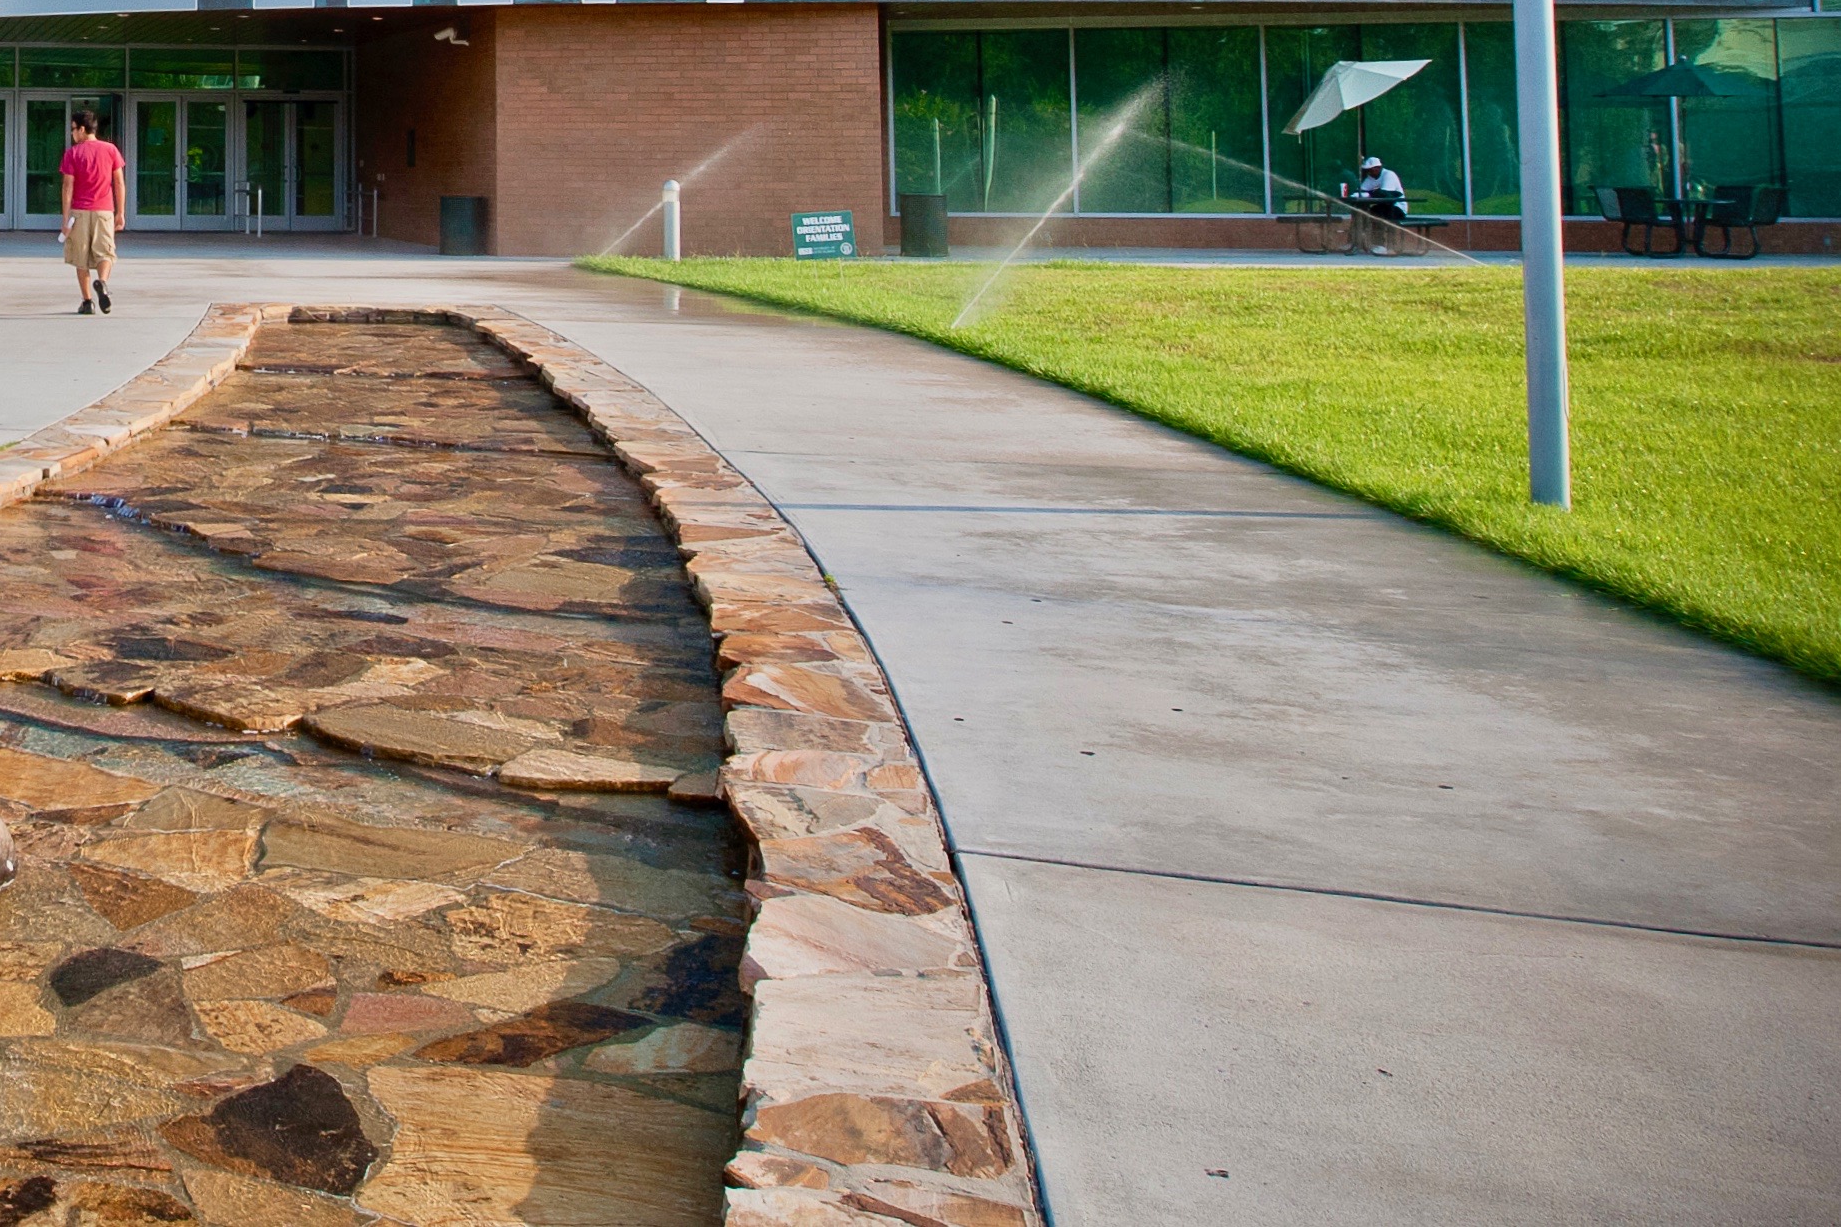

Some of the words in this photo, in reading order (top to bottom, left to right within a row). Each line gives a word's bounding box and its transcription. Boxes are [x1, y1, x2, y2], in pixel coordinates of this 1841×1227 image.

[802, 216, 843, 225] WELCOME
[796, 224, 850, 234] ORIENTATION
[805, 233, 843, 242] FAMILIES
